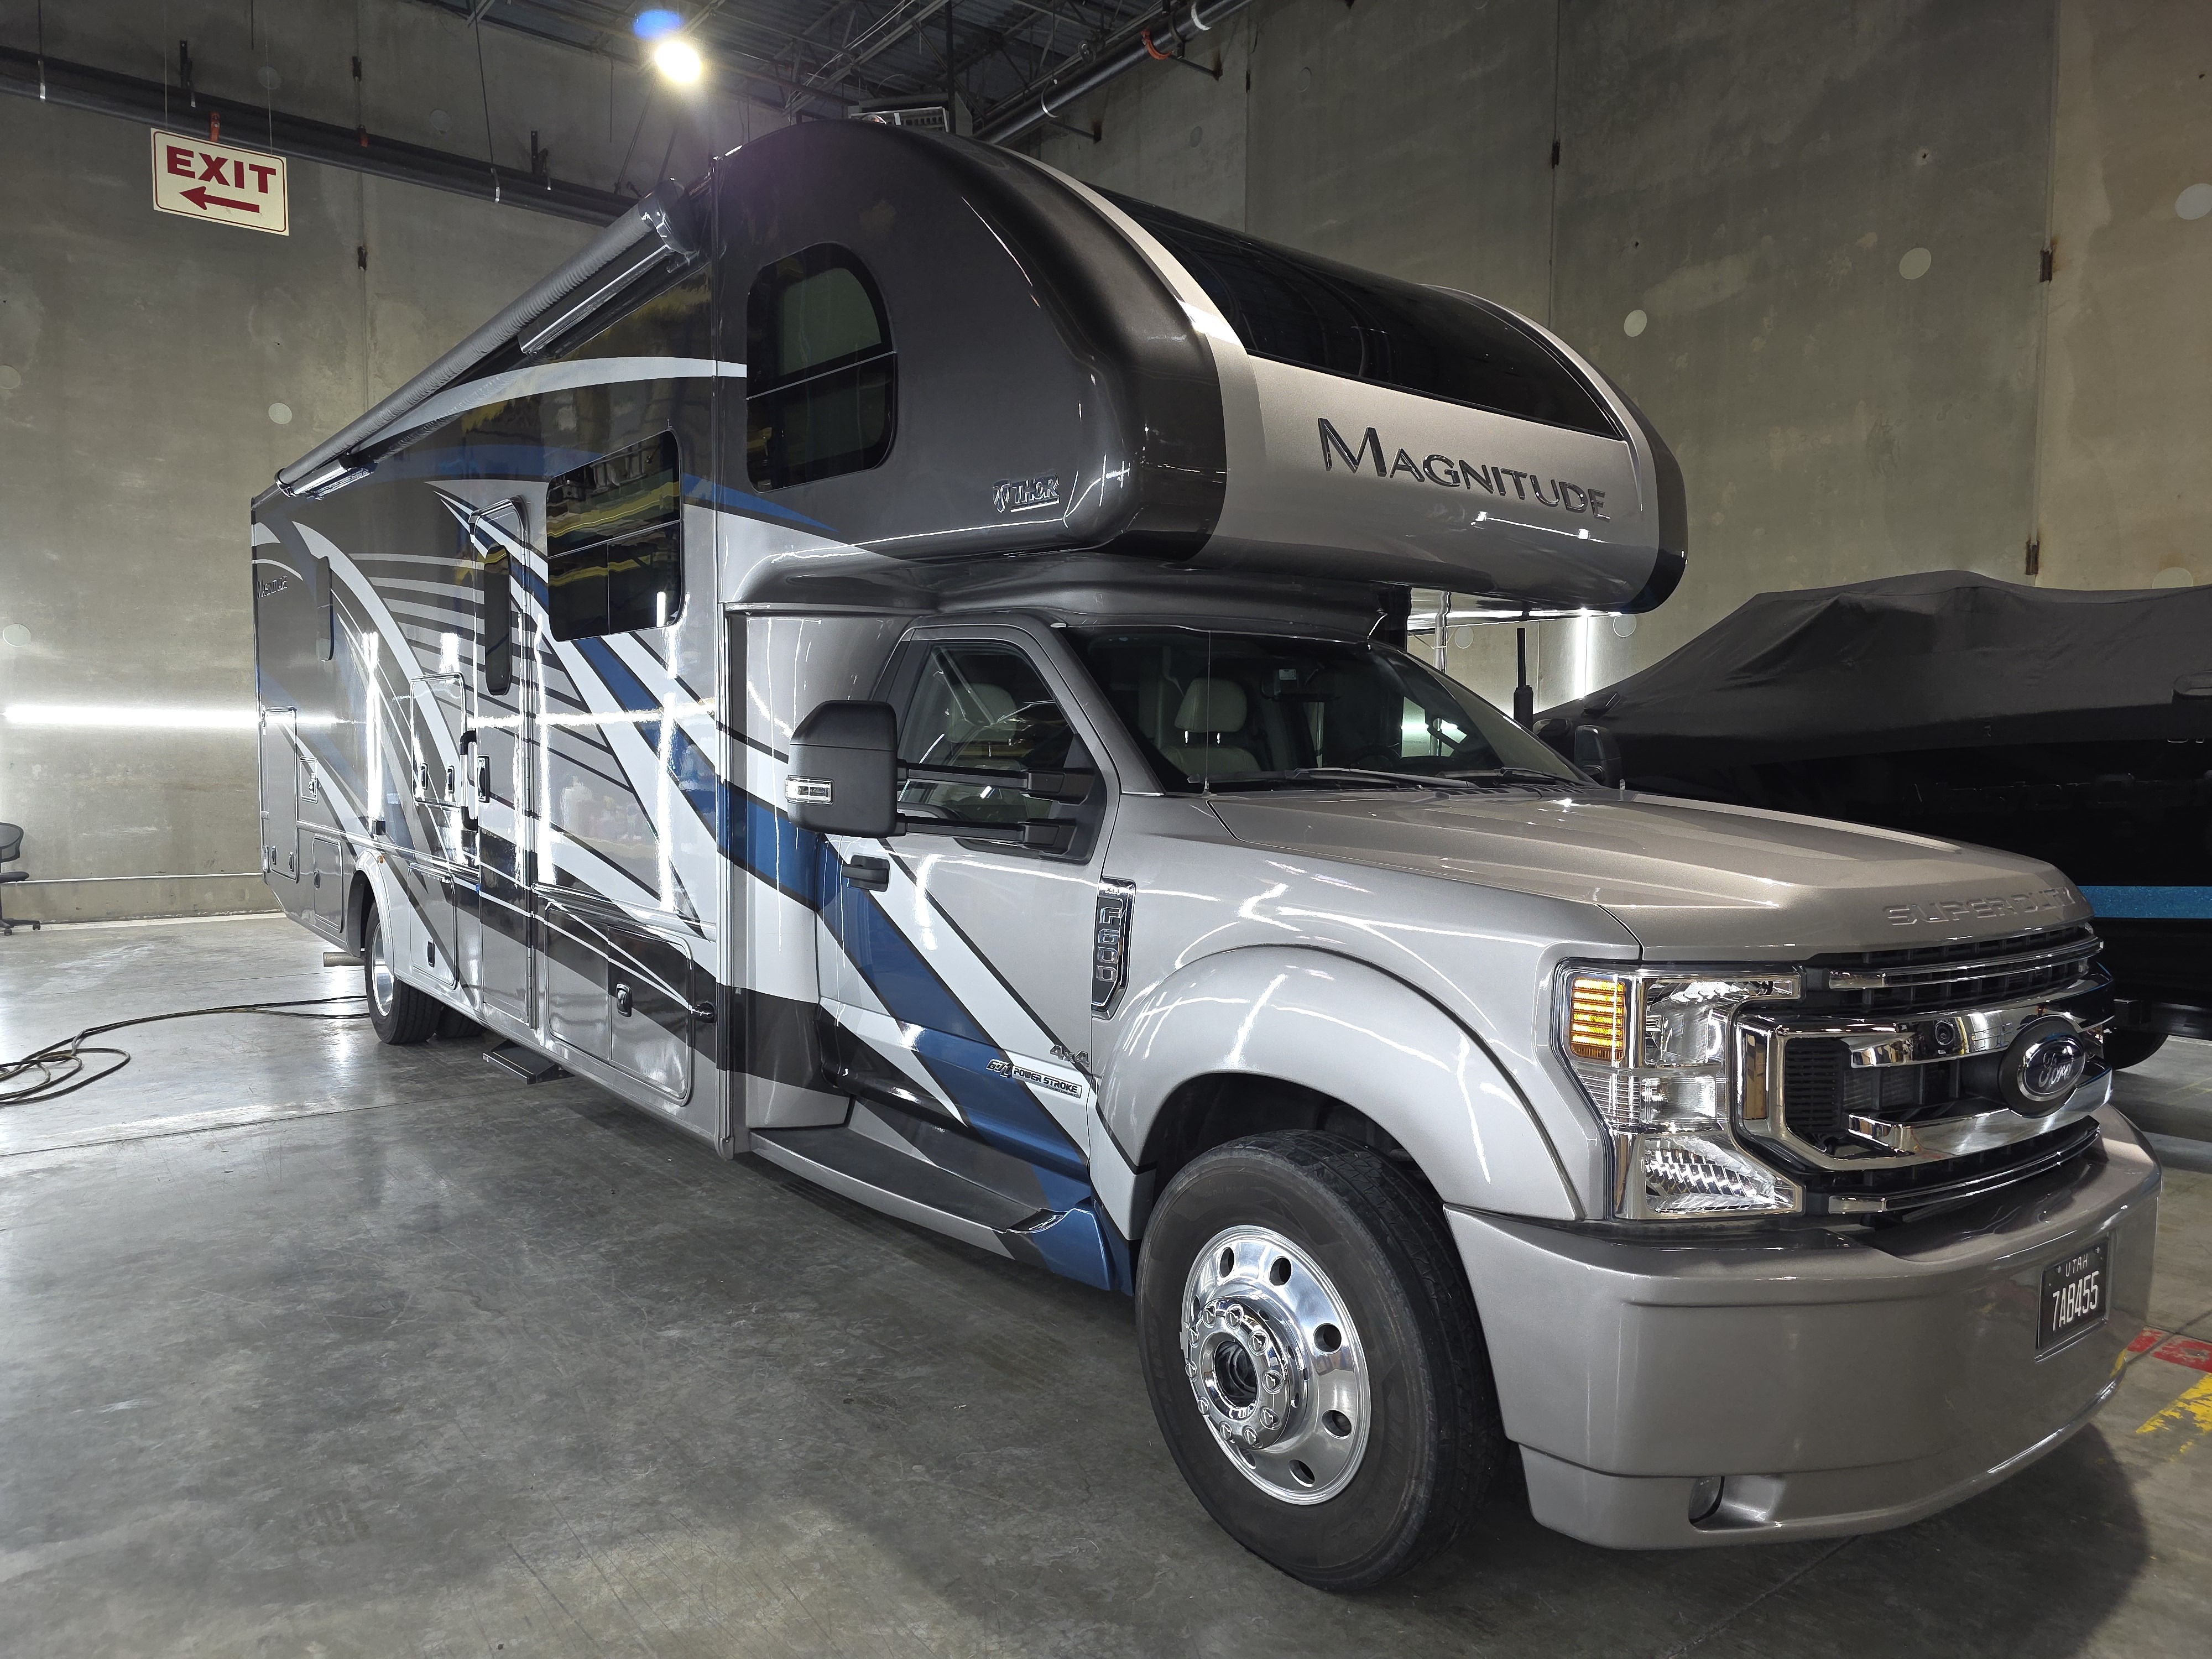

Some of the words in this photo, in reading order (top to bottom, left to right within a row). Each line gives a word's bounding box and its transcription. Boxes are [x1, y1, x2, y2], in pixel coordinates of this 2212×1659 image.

[166, 145, 276, 194] EXIT
[1318, 418, 1610, 521] MAGNITUDE
[1010, 474, 1060, 504] THOR
[1882, 896, 2018, 926] SUPER
[1014, 1068, 1042, 1083] POWER
[1043, 1077, 1078, 1094] STROKE
[2038, 1050, 2074, 1091] Ford
[2065, 1253, 2088, 1277] UTAH
[2052, 1270, 2099, 1331] 7AB455
